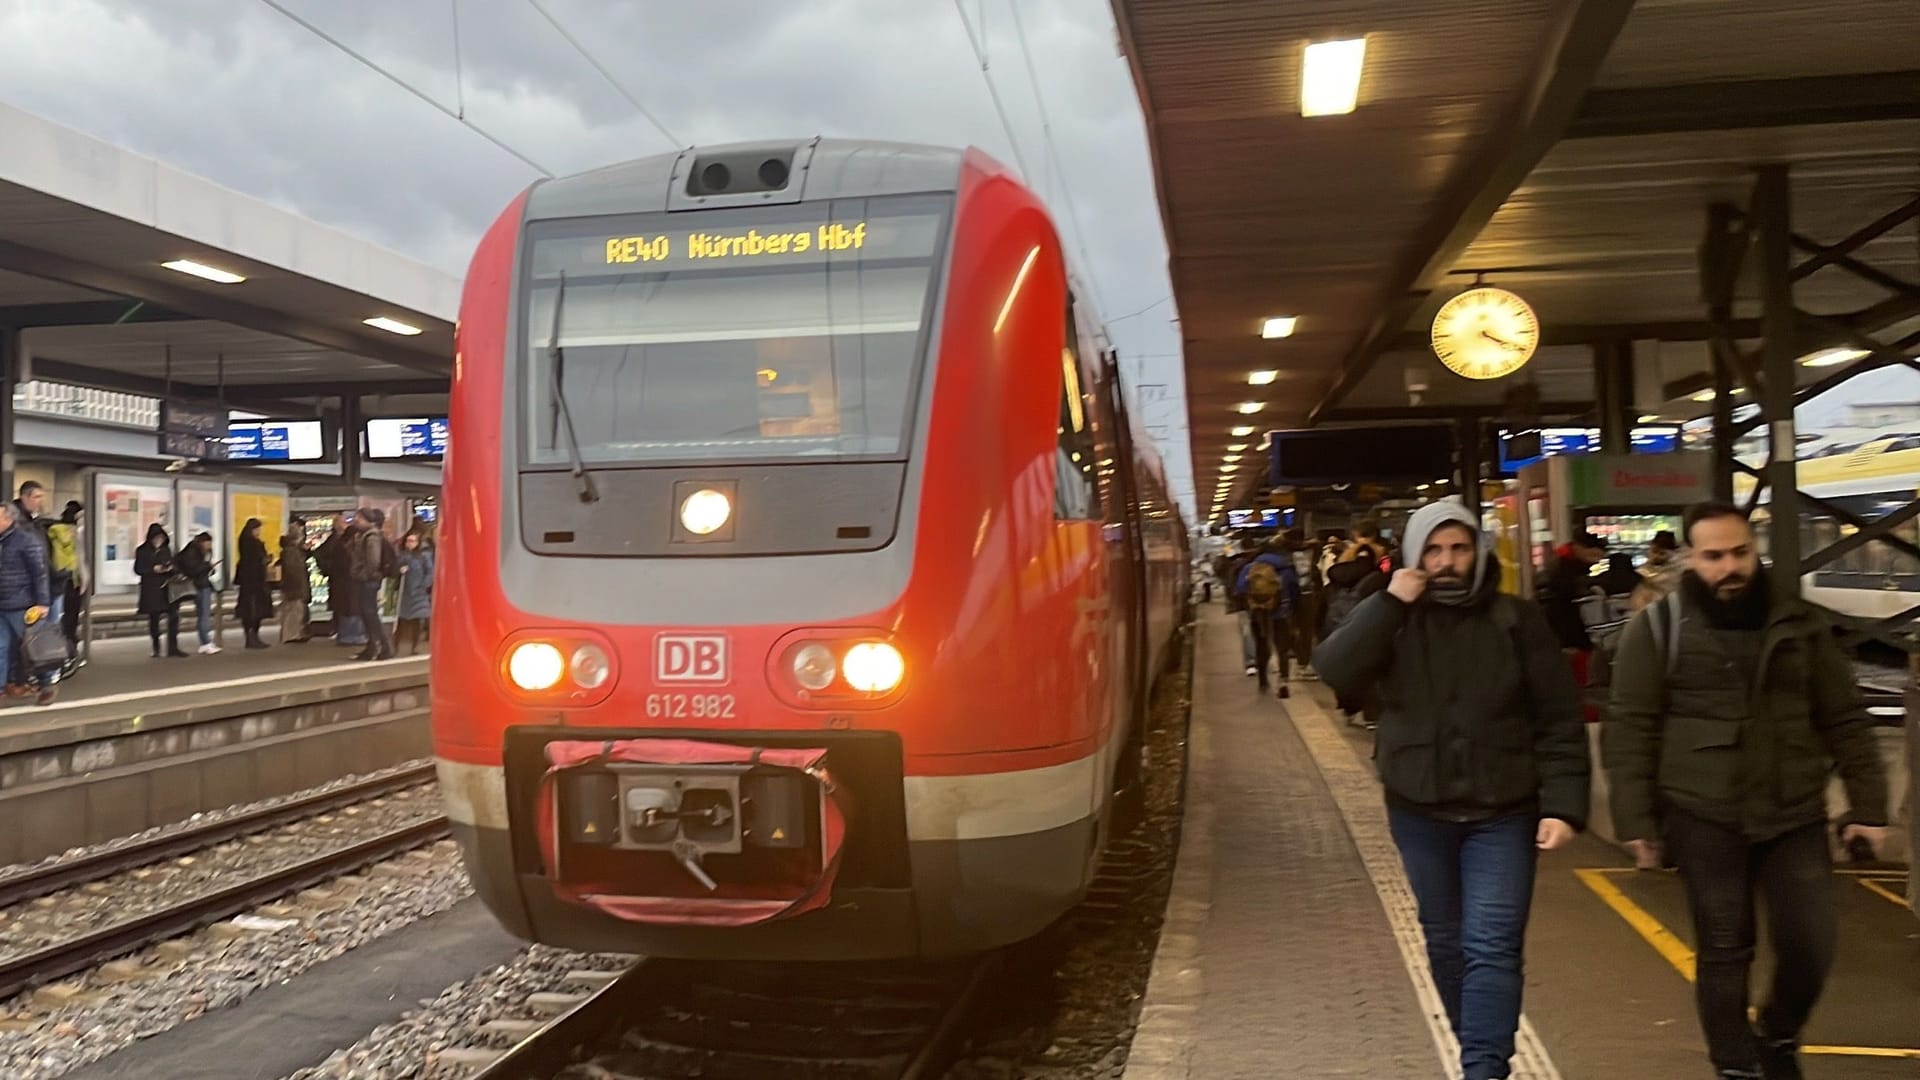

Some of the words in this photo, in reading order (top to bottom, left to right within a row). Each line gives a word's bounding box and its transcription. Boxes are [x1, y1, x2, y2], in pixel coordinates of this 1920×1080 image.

[606, 236, 669, 264] RE40
[688, 230, 810, 259] Nürnberg
[818, 223, 866, 251] Hbf
[664, 641, 720, 676] DB
[646, 693, 688, 718] 612
[691, 693, 736, 719] 982
